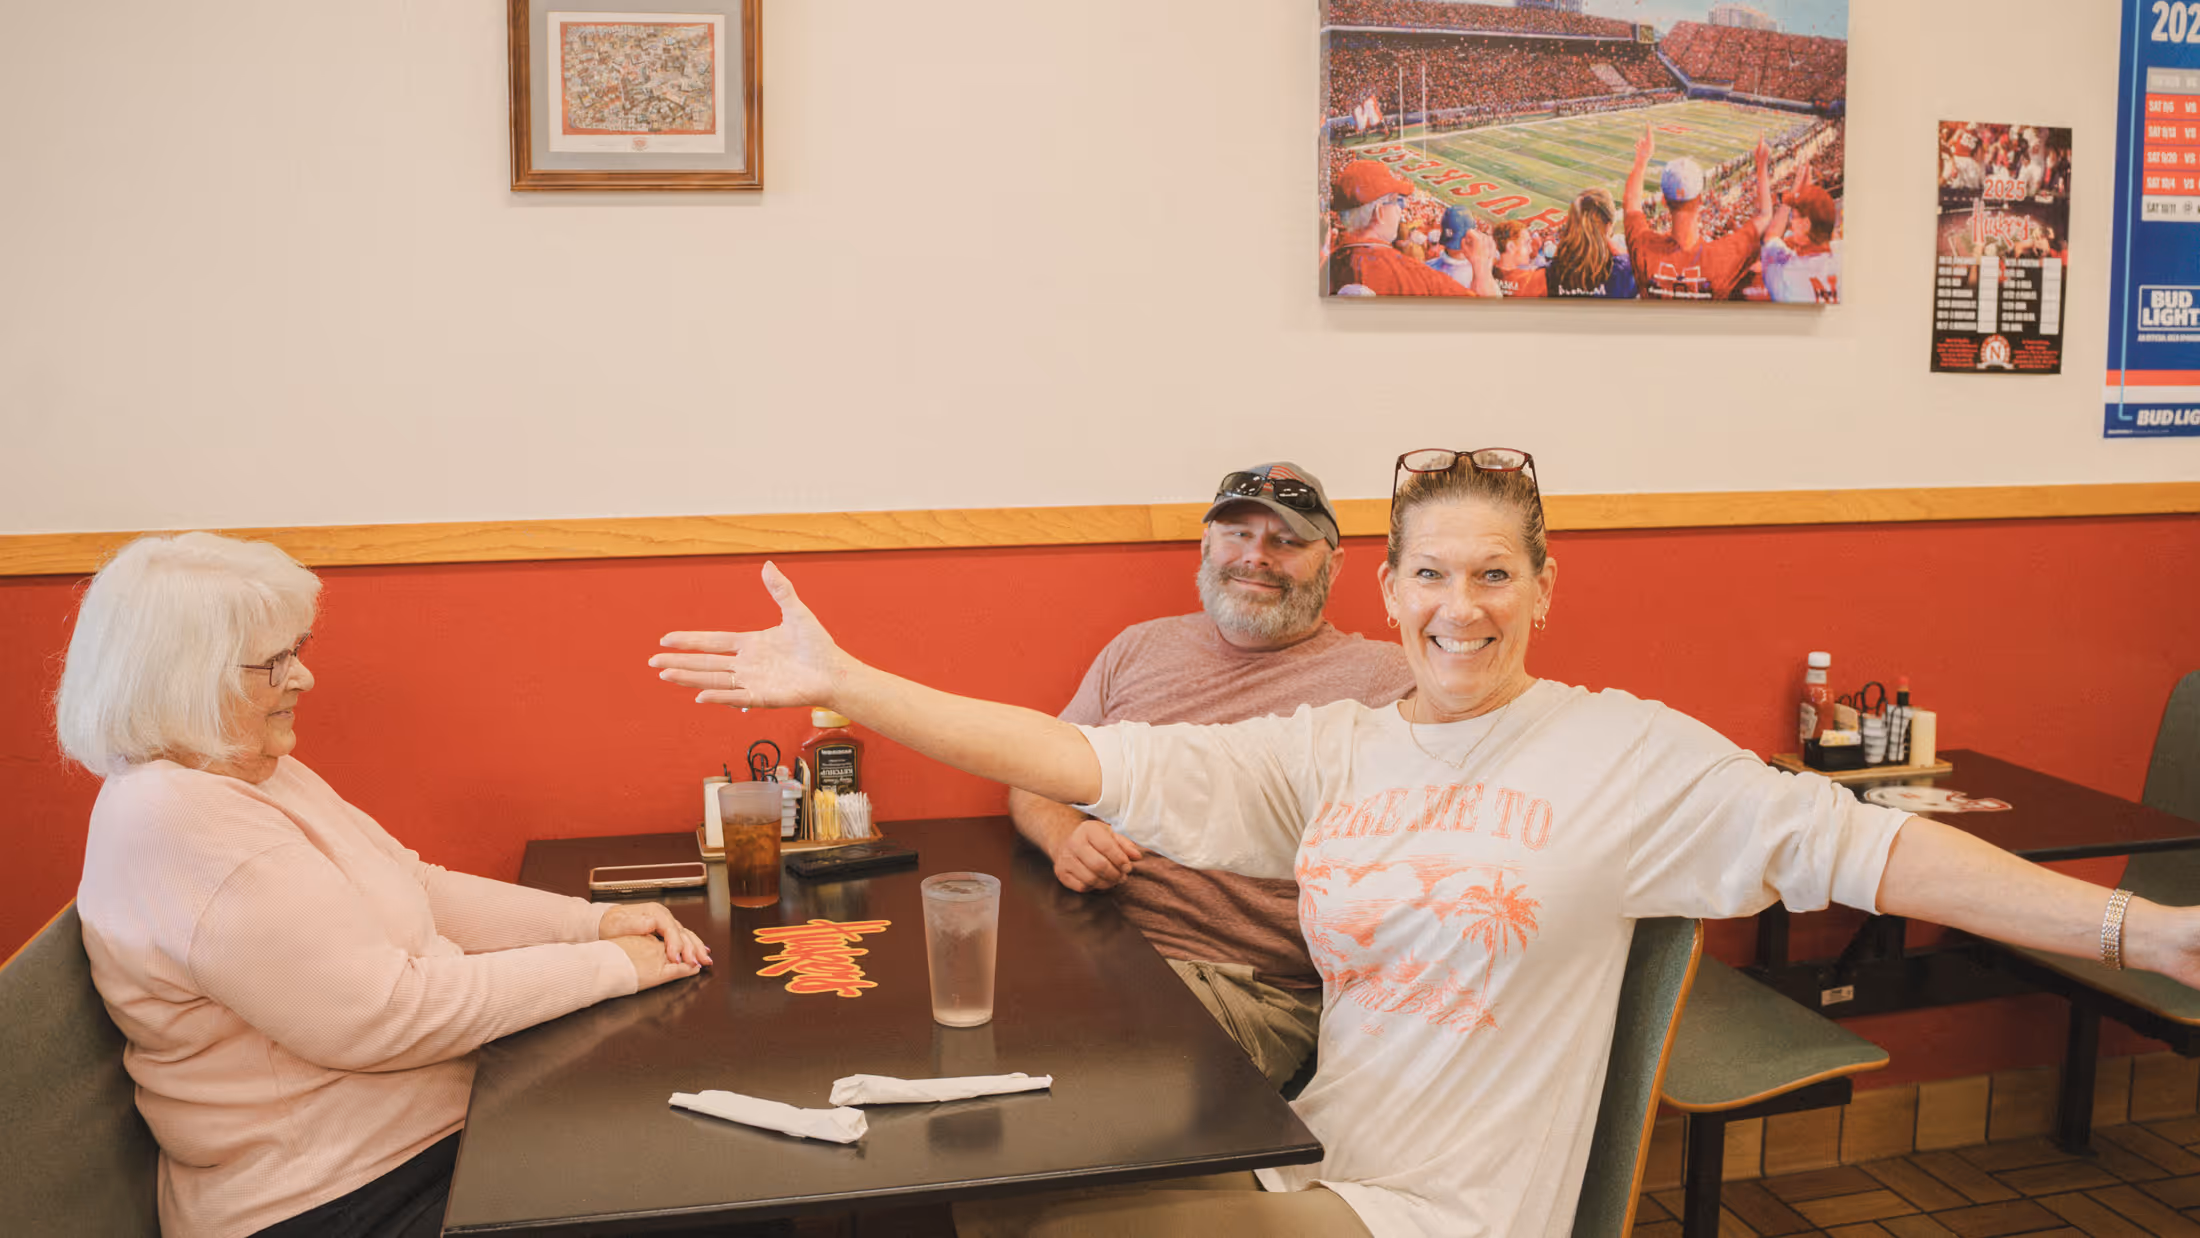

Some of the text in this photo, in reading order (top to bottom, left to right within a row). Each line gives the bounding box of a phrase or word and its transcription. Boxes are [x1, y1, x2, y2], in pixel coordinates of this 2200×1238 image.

[2149, 100, 2161, 112] SAT
[2147, 151, 2161, 163] SAT
[2184, 152, 2196, 164] VS
[1983, 178, 2026, 201] 2025
[2146, 176, 2160, 188] SAT
[2183, 178, 2195, 190] VS
[2151, 290, 2193, 308] BUD
[2142, 307, 2200, 326] LIGHT
[1990, 344, 2001, 360] N
[2137, 409, 2173, 426] BUD
[1490, 785, 1553, 852] TO
